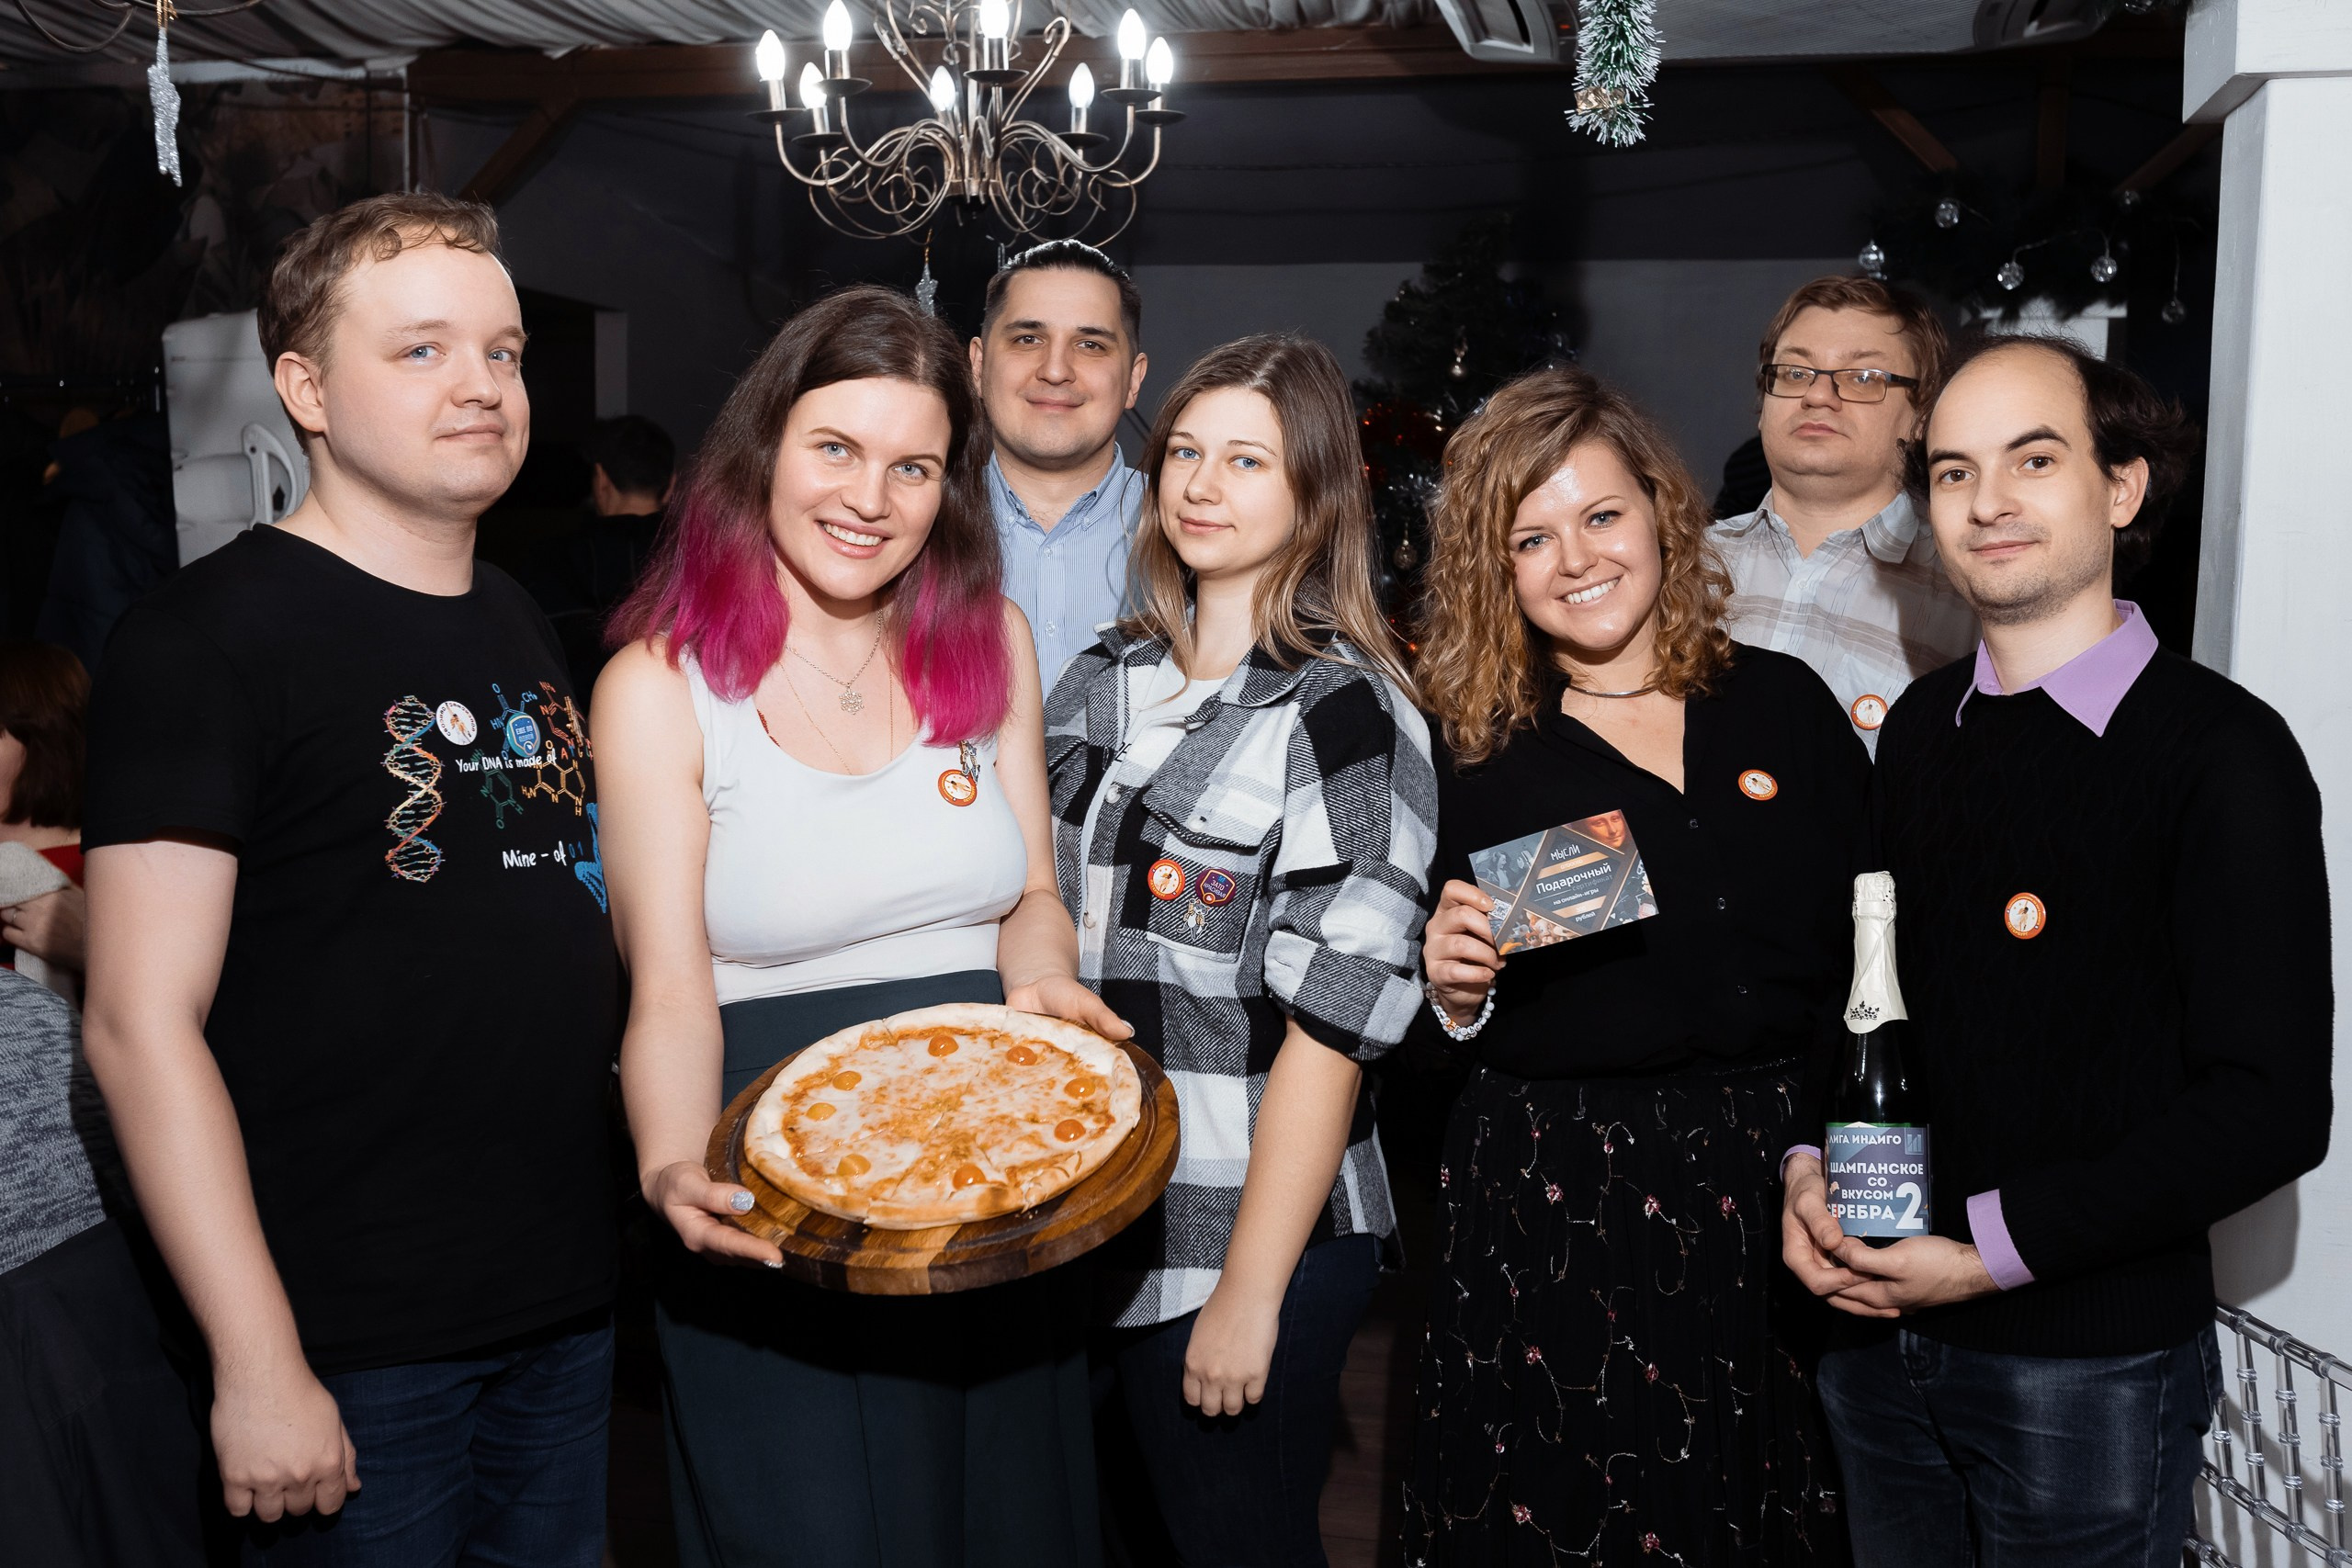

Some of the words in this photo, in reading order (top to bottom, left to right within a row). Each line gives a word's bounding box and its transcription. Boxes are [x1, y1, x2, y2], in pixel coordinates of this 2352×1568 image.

[456, 759, 479, 773] Your
[482, 756, 503, 771] DNA
[505, 759, 514, 769] is
[515, 755, 543, 768] made
[547, 747, 557, 766] of
[502, 851, 537, 870] Mine
[553, 840, 568, 866] of
[1210, 879, 1225, 891] ЗАТО
[1535, 863, 1612, 895] Подарочный
[1572, 874, 1613, 892] сертификат
[1561, 887, 1599, 904] онлайн-игры
[1852, 1134, 1902, 1145] ИНДИГО
[1829, 1162, 1924, 1175] ШАМПАНСКОЕ
[1867, 1177, 1888, 1187] СО
[1841, 1189, 1894, 1201] ВКУСОМ
[1895, 1181, 1924, 1230] 2
